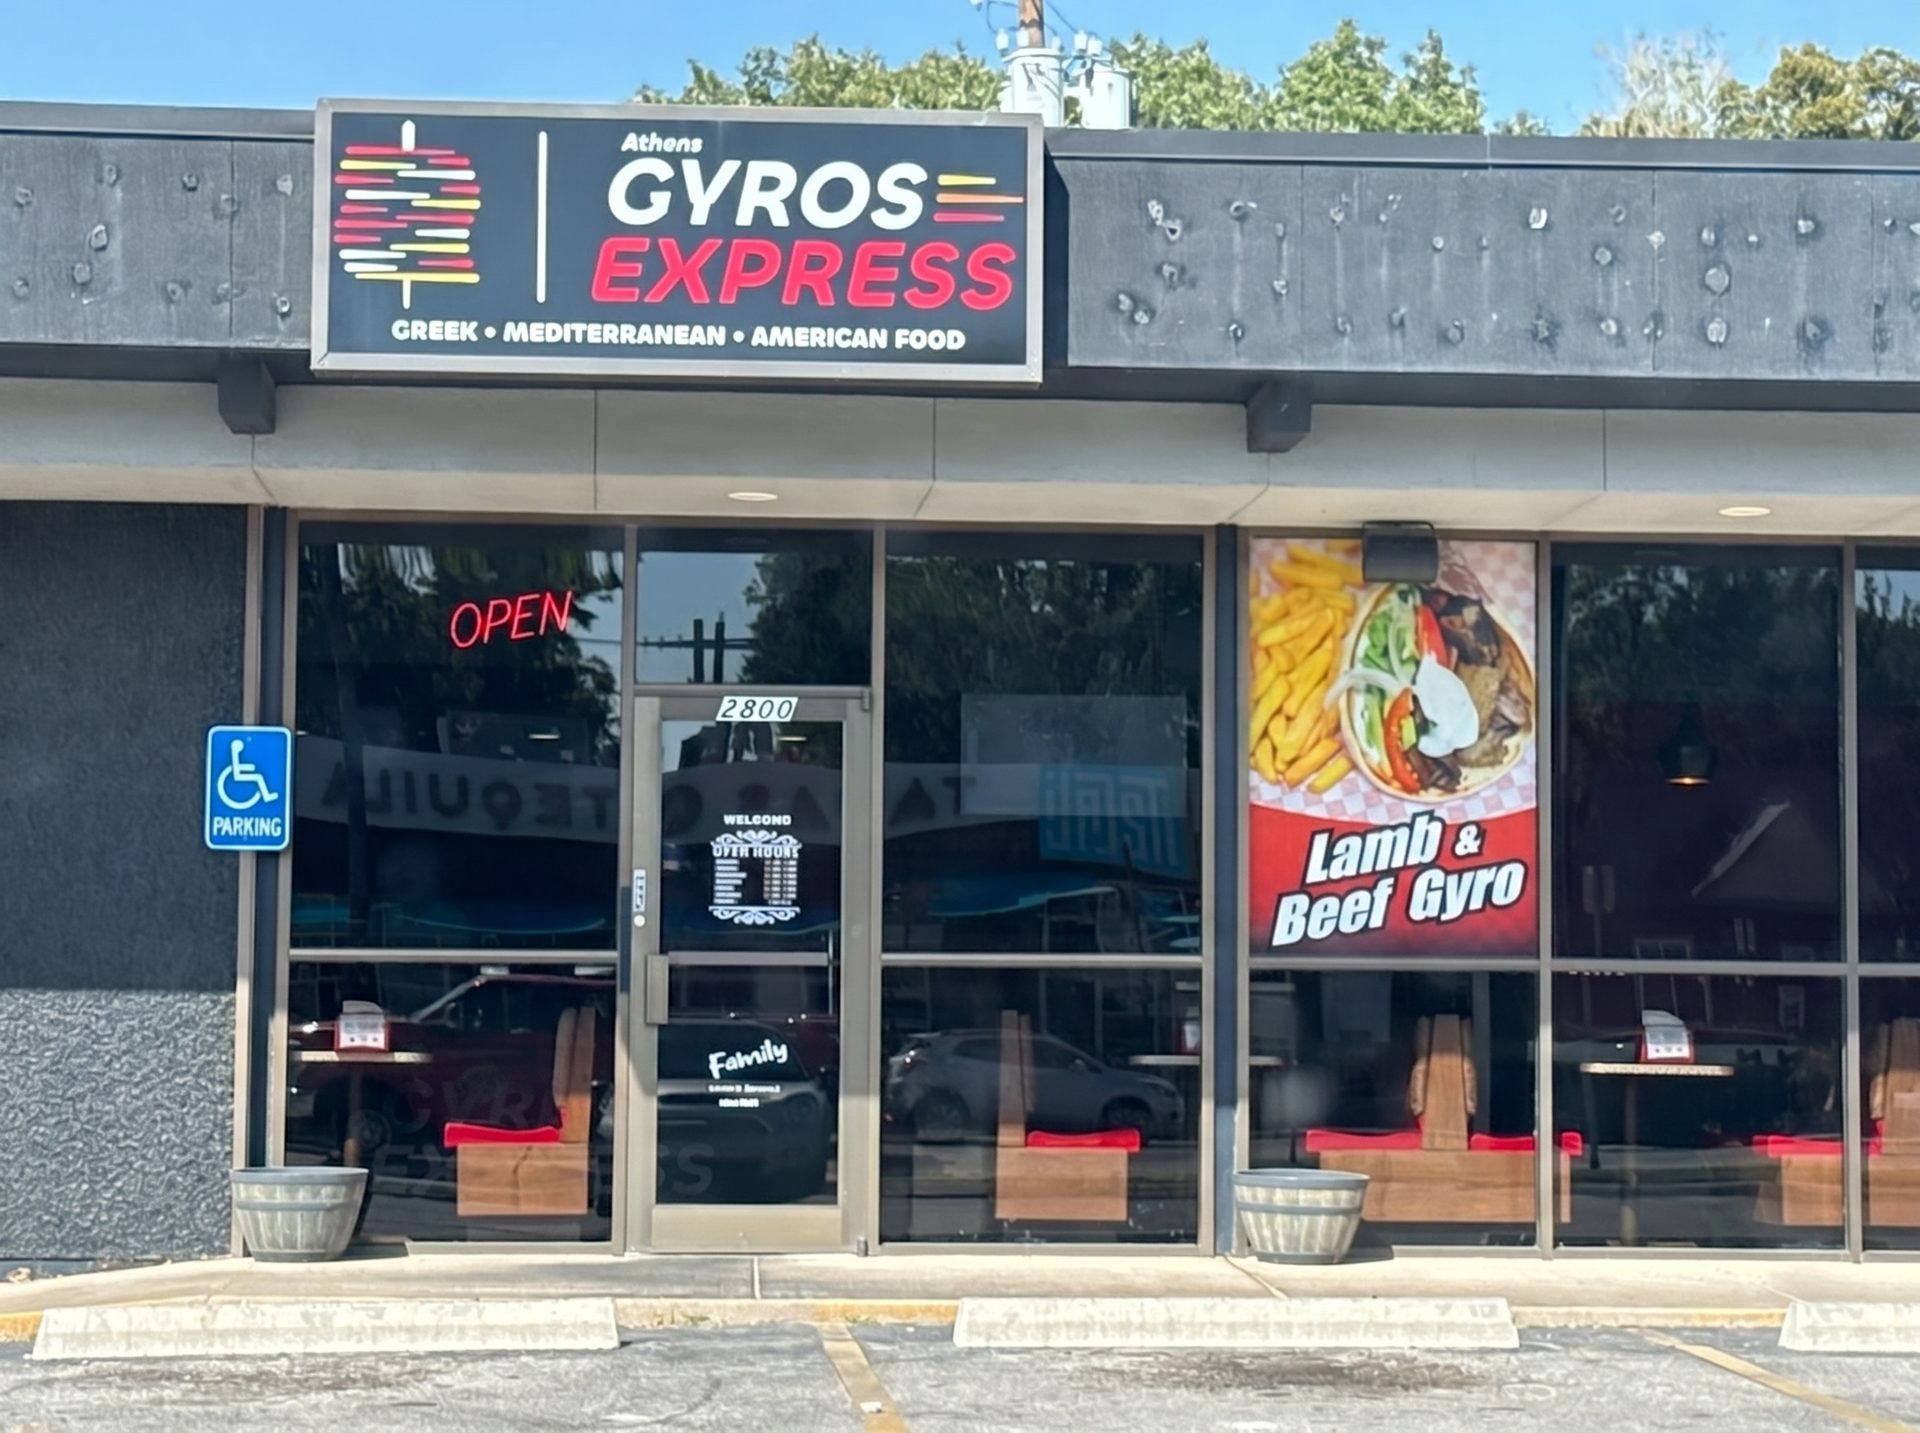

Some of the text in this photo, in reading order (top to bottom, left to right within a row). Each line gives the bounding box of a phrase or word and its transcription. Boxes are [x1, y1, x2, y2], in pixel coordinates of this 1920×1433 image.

[621, 132, 703, 152] Athens
[607, 157, 928, 229] GYROS
[591, 237, 1017, 310] EXPRESS
[391, 320, 966, 351] GREEK MEDITERRANEAN AMERICAN FOOD
[449, 590, 573, 648] OPEN
[721, 698, 794, 719] 2800
[213, 817, 283, 837] PARKING
[1306, 814, 1481, 884] Lamb &
[1272, 862, 1526, 947] Beef Gyro
[709, 1038, 788, 1079] Family
